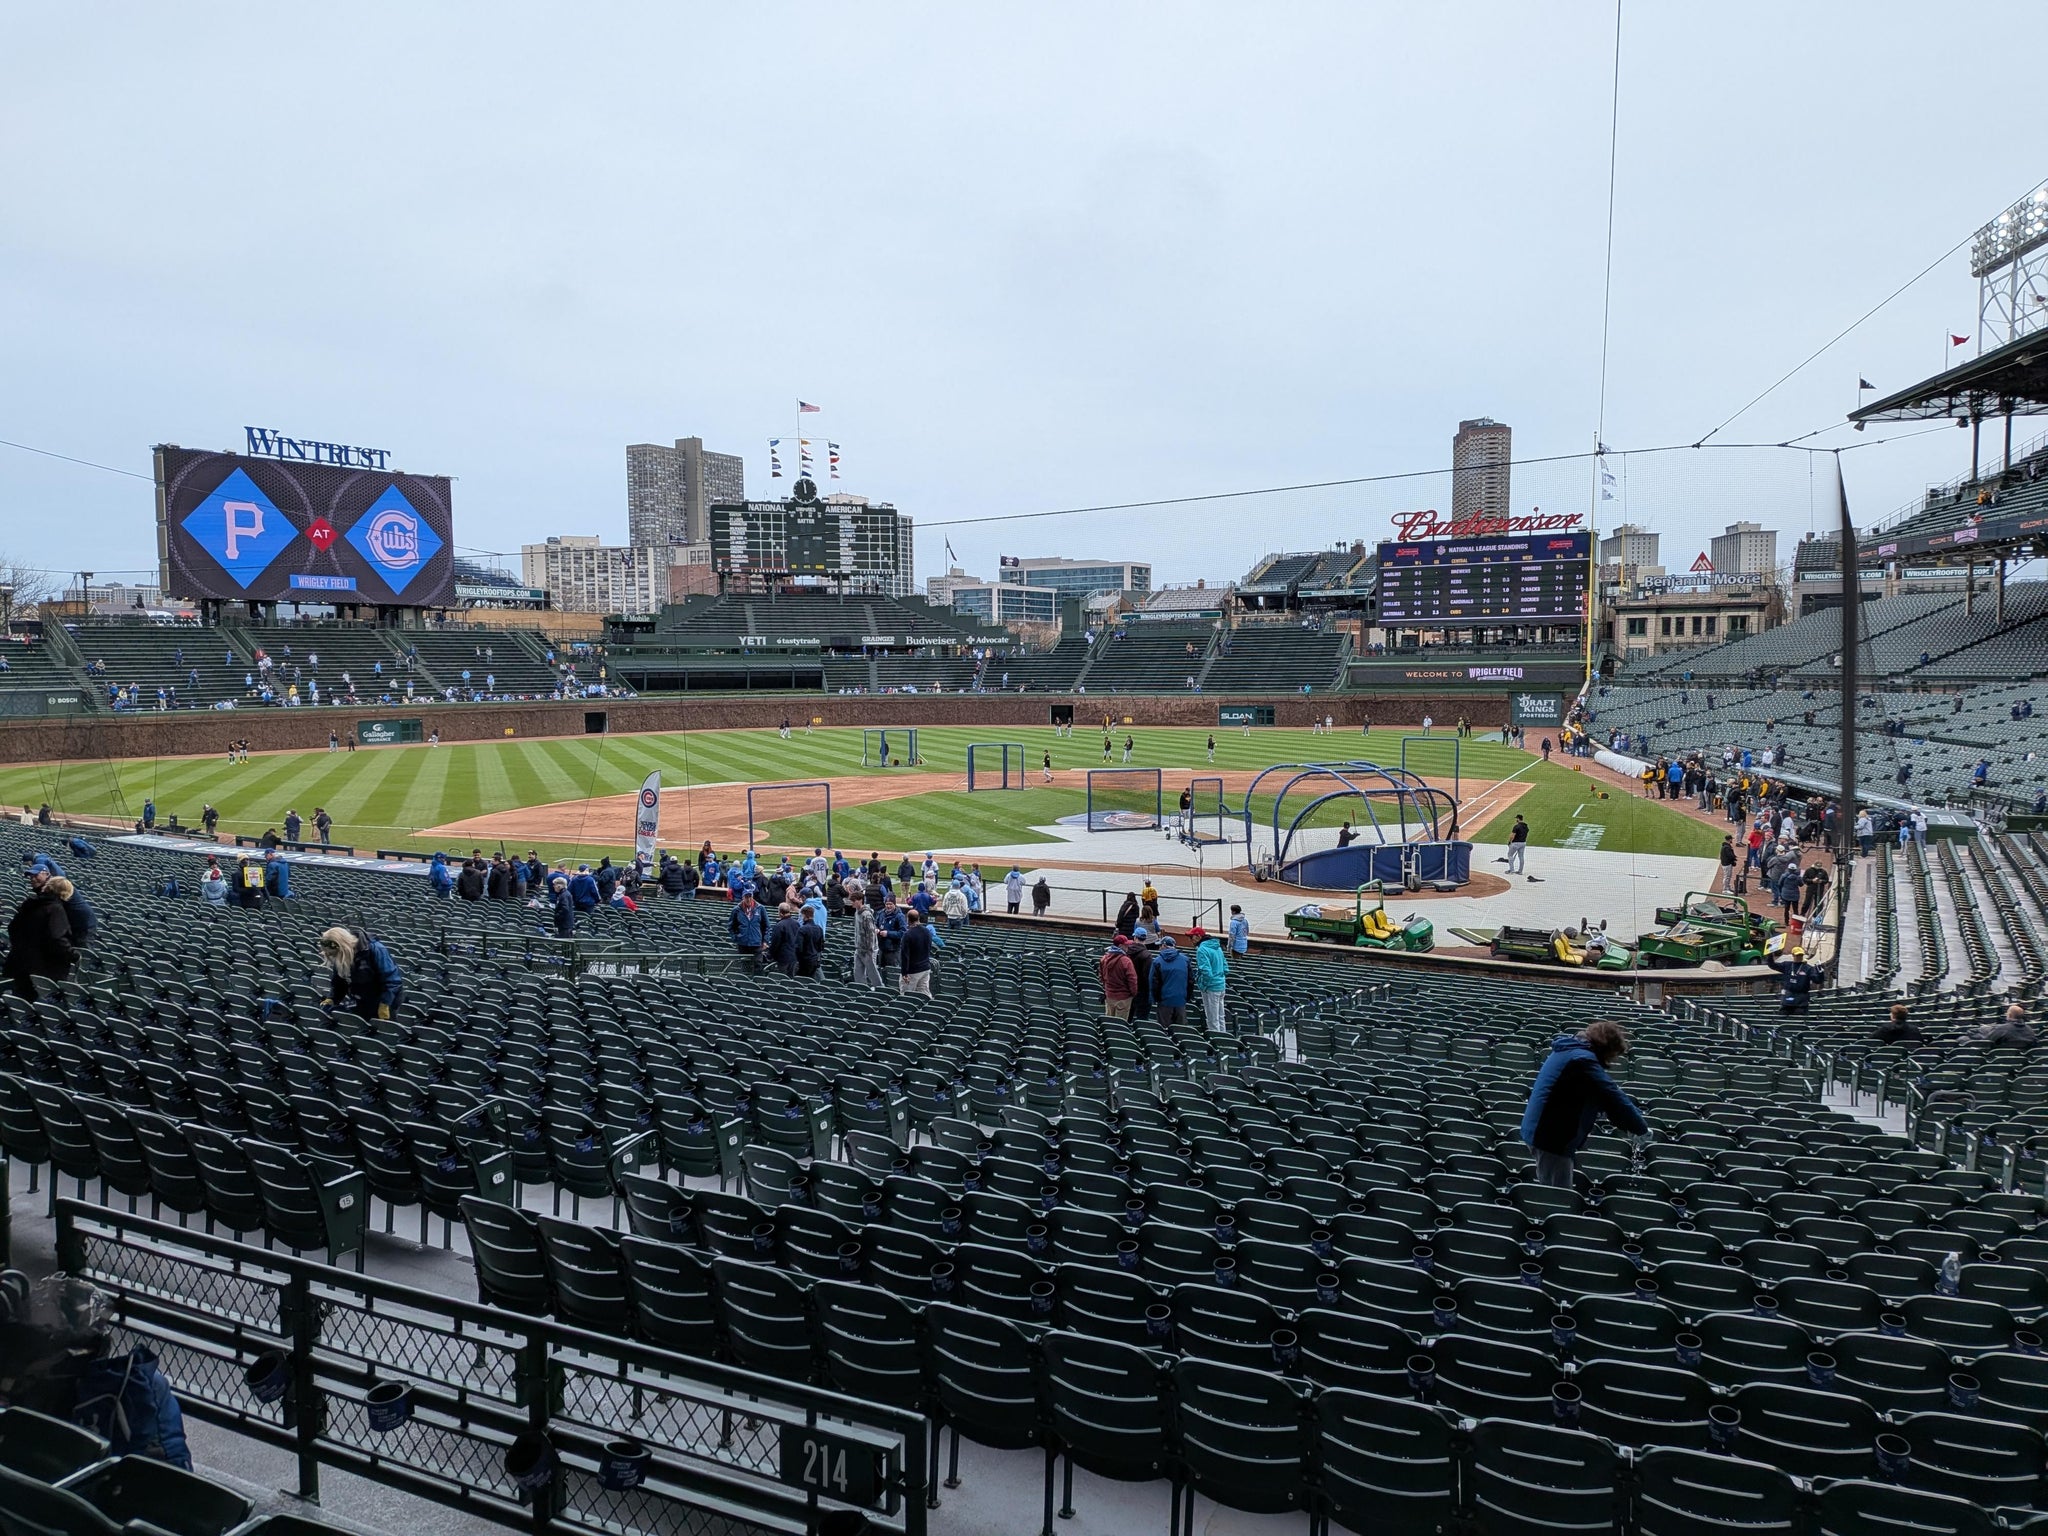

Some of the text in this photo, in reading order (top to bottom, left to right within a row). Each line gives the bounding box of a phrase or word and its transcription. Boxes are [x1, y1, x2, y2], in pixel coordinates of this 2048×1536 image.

[244, 426, 391, 470] WINTRUST
[748, 504, 786, 512] NATIONAL
[1391, 507, 1583, 542] Budweiser
[223, 501, 265, 560] P
[313, 529, 330, 539] AT
[1906, 567, 1990, 577] WRIGLEYROOFTOP.COM
[298, 576, 349, 589] WRIGLEY FIELD
[1644, 573, 1761, 588] Benjamin Moore
[455, 586, 530, 598] WRIGLEYROOFTOPS.COM
[739, 636, 766, 646] YETI
[782, 637, 820, 646] tastytrade
[976, 636, 1009, 644] Advocate
[1469, 667, 1501, 679] WRIGLEY
[1502, 667, 1523, 679] FIELD
[1520, 699, 1556, 707] DRAFT
[816, 863, 825, 871] 12
[342, 1196, 351, 1205] 15
[803, 1439, 848, 1493] 214
